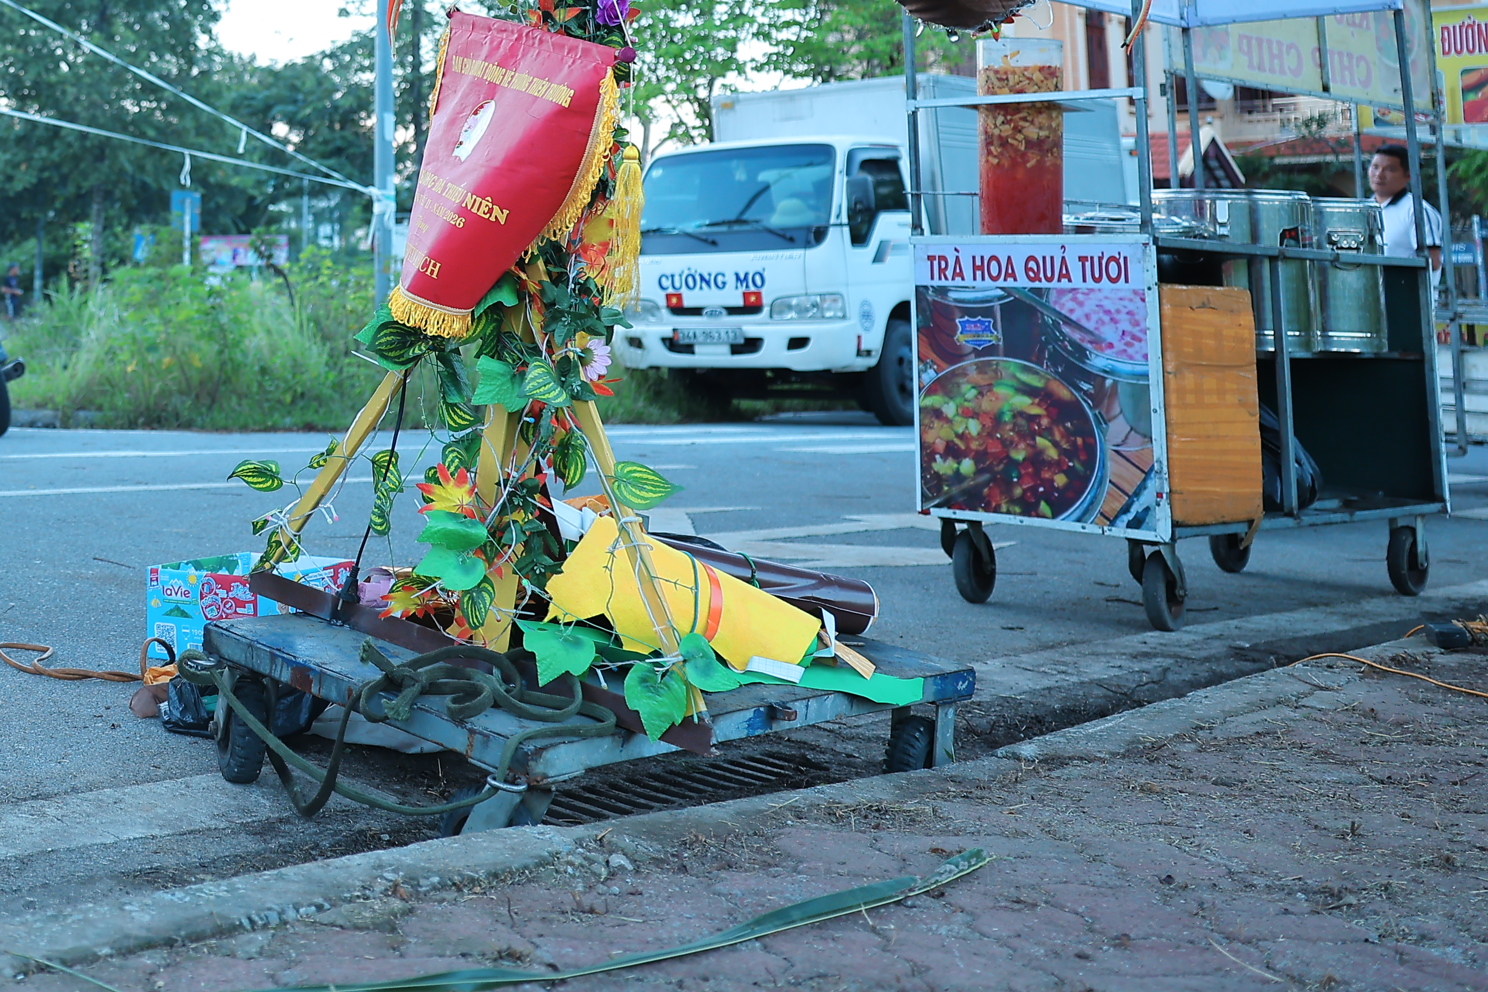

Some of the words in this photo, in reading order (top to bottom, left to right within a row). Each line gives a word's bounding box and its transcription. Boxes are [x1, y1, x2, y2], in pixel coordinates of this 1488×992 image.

[443, 210, 467, 229] 2026
[462, 195, 510, 225] NIÊN
[927, 247, 966, 282] TRÀ
[972, 254, 1018, 282] HOA
[1024, 245, 1073, 284] QUẢ
[1078, 251, 1130, 284] TƯƠI
[658, 267, 728, 291] CƯỜNG
[162, 585, 192, 599] laVie
